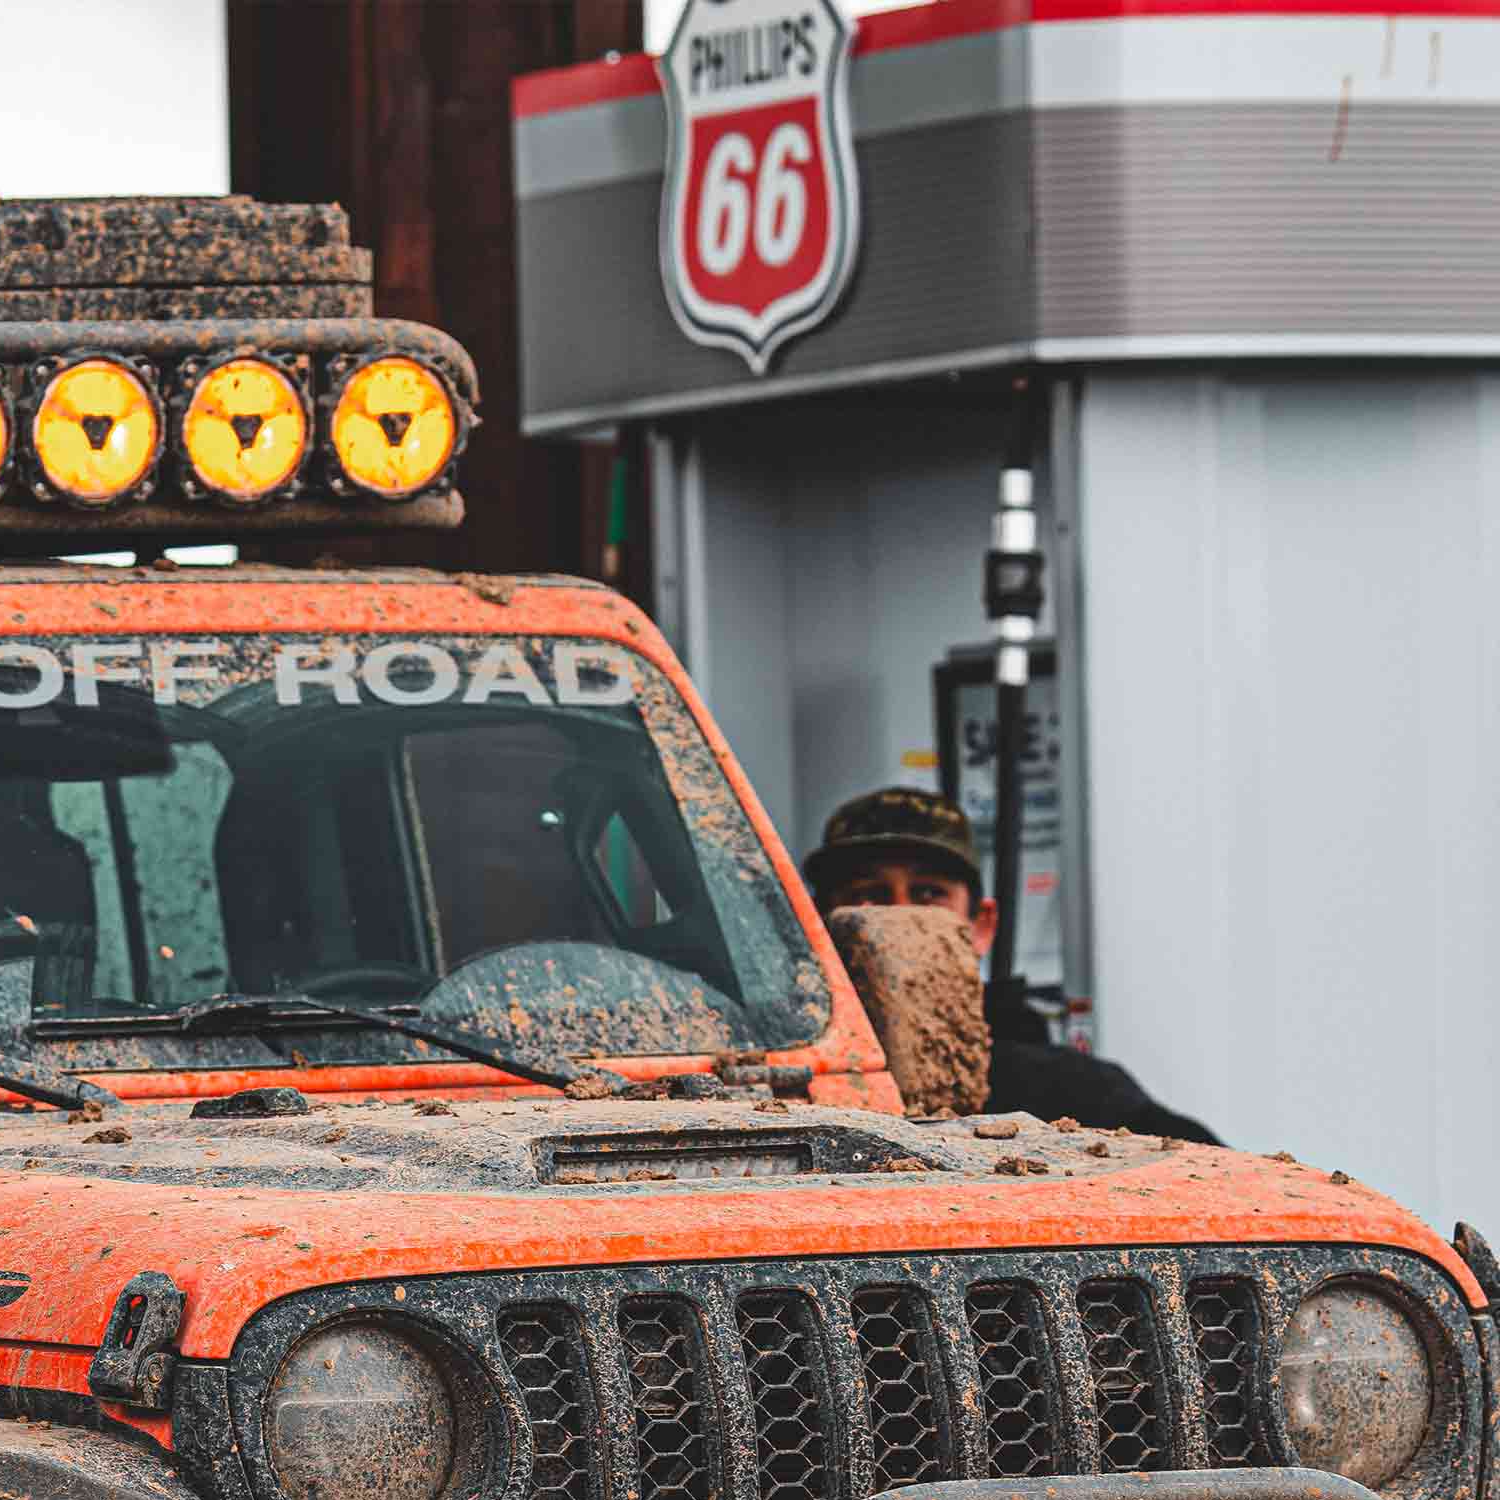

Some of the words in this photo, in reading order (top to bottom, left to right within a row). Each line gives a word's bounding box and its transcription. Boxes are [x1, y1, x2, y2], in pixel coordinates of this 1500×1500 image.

[690, 14, 817, 95] PHILLIPS
[697, 122, 812, 277] 66
[274, 641, 634, 708] ROAD
